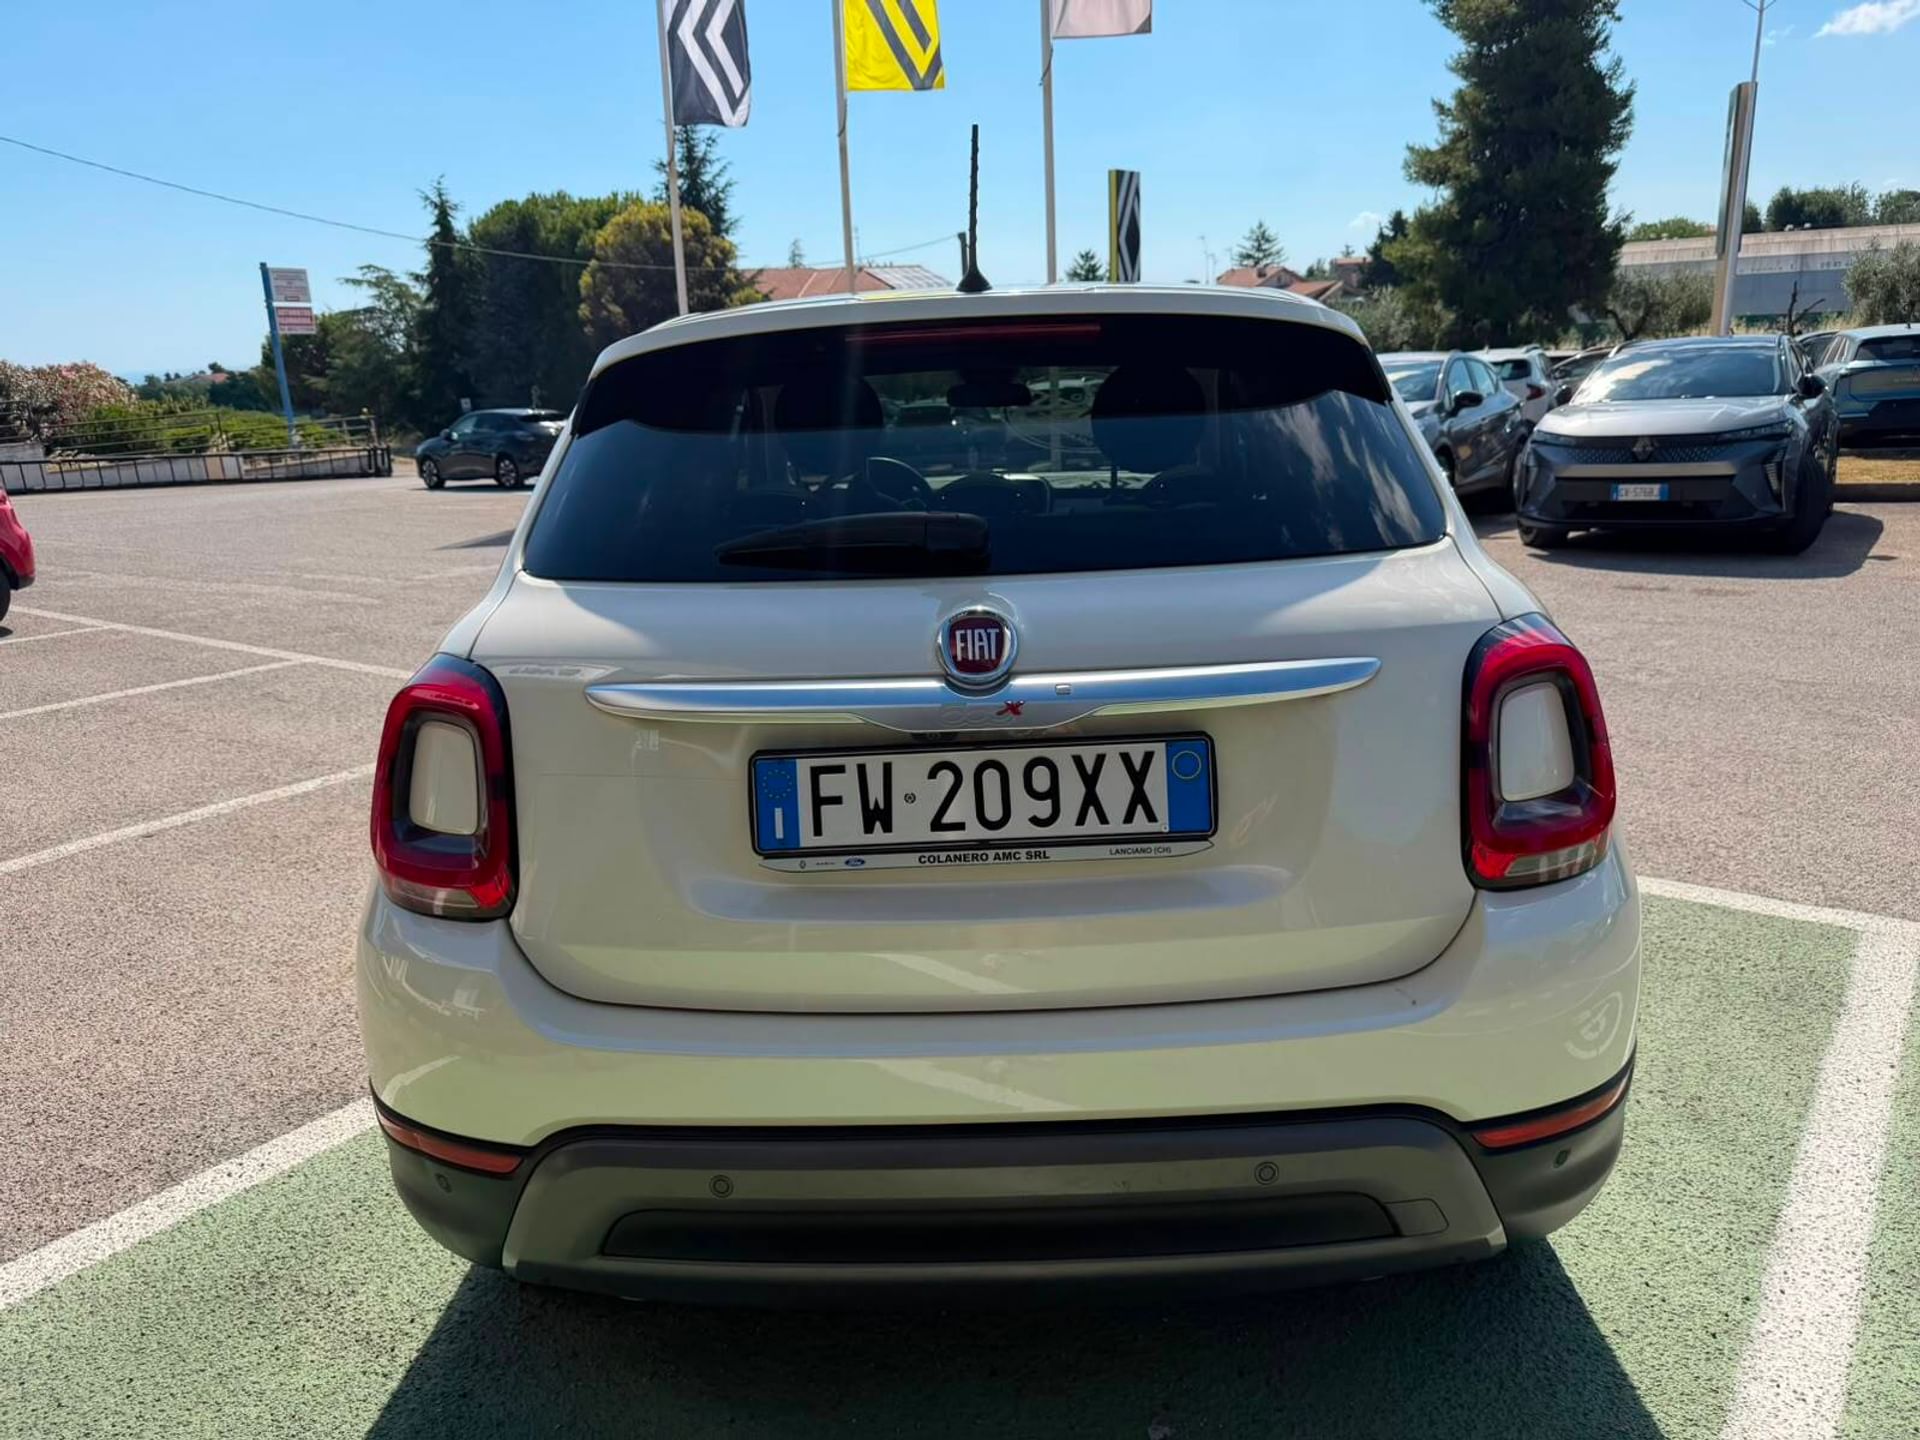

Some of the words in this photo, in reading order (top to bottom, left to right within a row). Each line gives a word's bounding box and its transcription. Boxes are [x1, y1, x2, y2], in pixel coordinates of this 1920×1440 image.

[955, 628, 999, 661] FIAT
[810, 761, 893, 837] FW
[927, 751, 1159, 832] 209XX
[918, 852, 989, 864] COLANERO
[993, 850, 1022, 862] AMC
[1025, 850, 1050, 860] SRL
[1109, 847, 1152, 856] LANCIANO
[1154, 846, 1172, 855] (CH)
